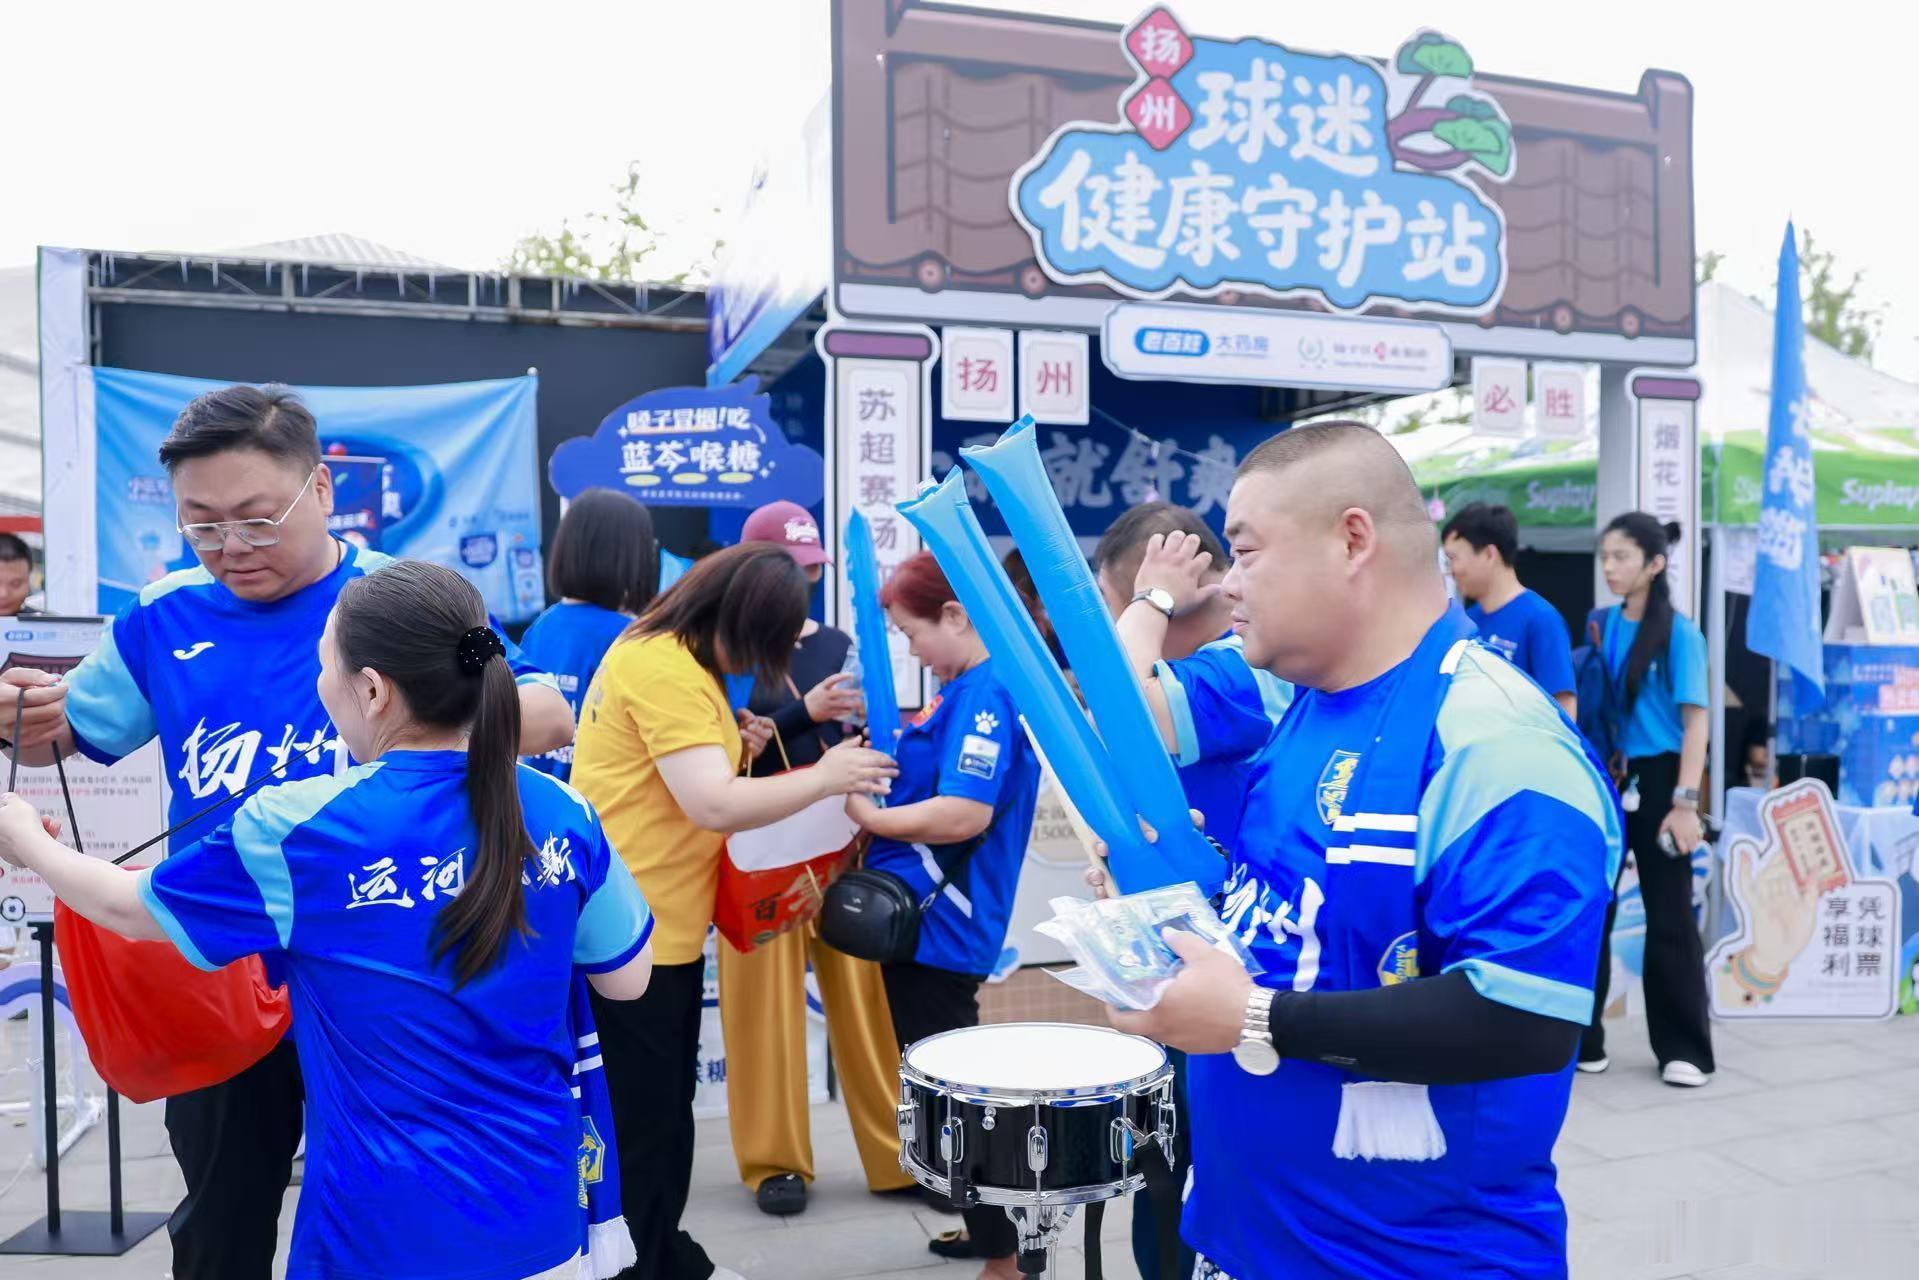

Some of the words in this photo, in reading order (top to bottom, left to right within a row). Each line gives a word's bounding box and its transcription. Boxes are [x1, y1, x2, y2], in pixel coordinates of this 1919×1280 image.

[1138, 25, 1180, 132] 扬州
[1188, 58, 1379, 177] 球迷
[1039, 149, 1486, 288] 健康守护站
[618, 439, 762, 474] 蓝芩喉糖
[178, 716, 350, 799] 扬州
[1821, 896, 1851, 977] 享福利
[1855, 895, 1885, 976] 凭球票
